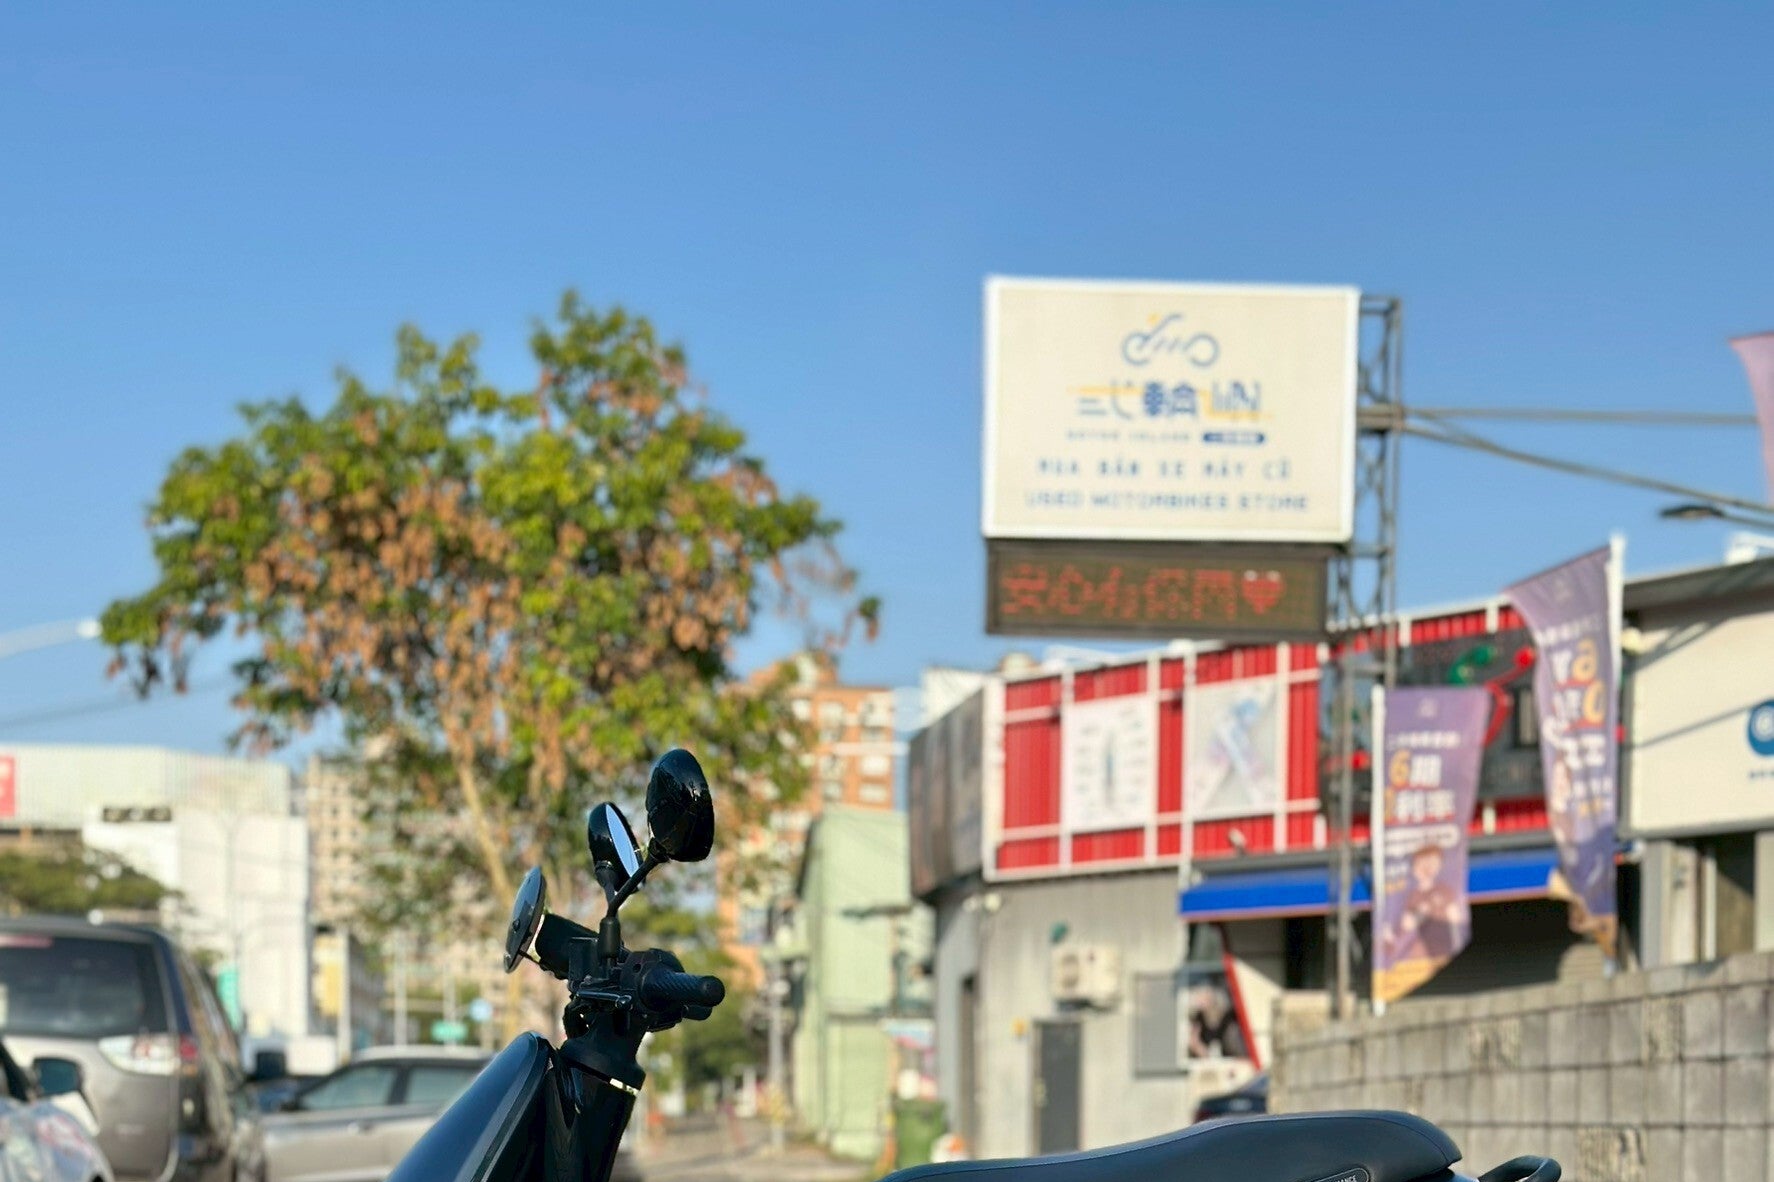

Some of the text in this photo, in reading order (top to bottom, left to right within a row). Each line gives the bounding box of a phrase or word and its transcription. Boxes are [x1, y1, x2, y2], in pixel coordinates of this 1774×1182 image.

[1025, 490, 1309, 512] USED MOTORBIKES STORE
